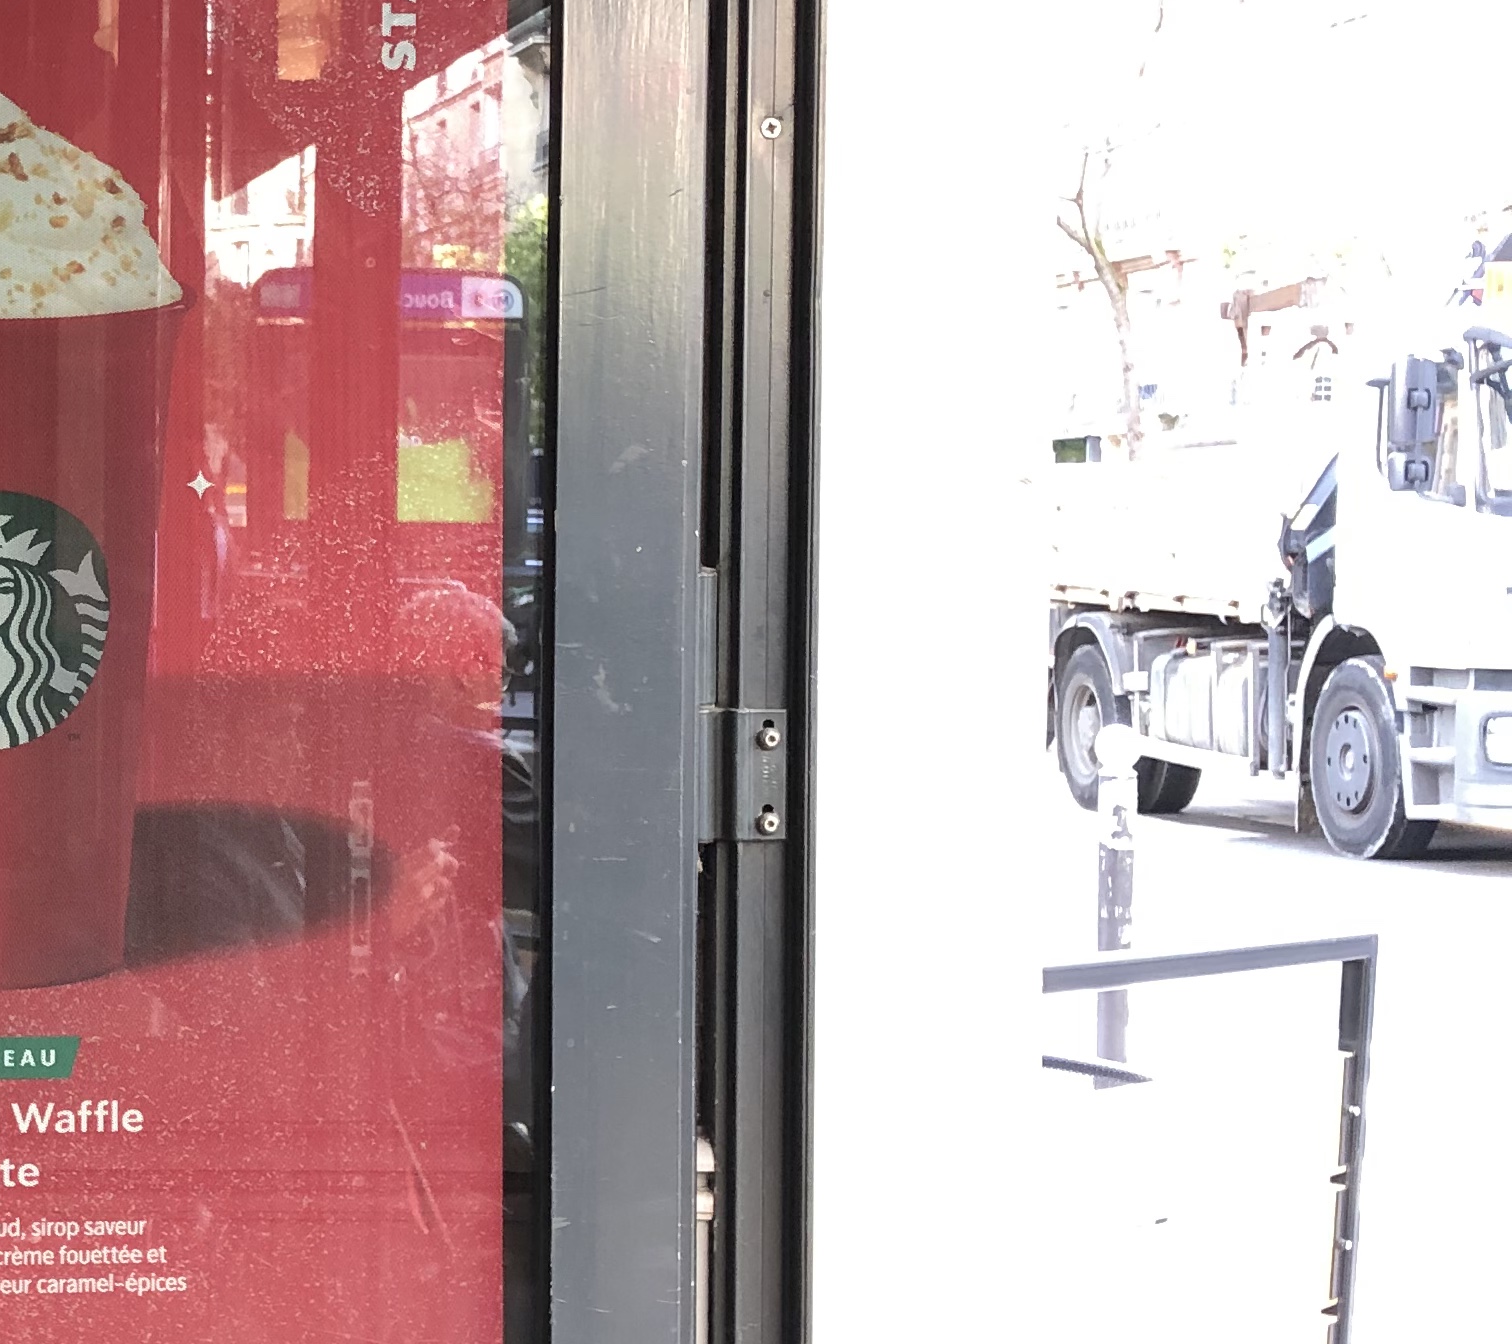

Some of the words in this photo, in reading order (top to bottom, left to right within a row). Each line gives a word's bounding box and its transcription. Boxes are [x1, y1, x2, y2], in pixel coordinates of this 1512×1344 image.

[11, 1100, 144, 1134] Waffle
[31, 1218, 80, 1244] sirop
[84, 1218, 148, 1237] saveur
[59, 1243, 143, 1265] fouettée
[147, 1245, 168, 1264] et
[36, 1273, 188, 1299] caramel-épices
